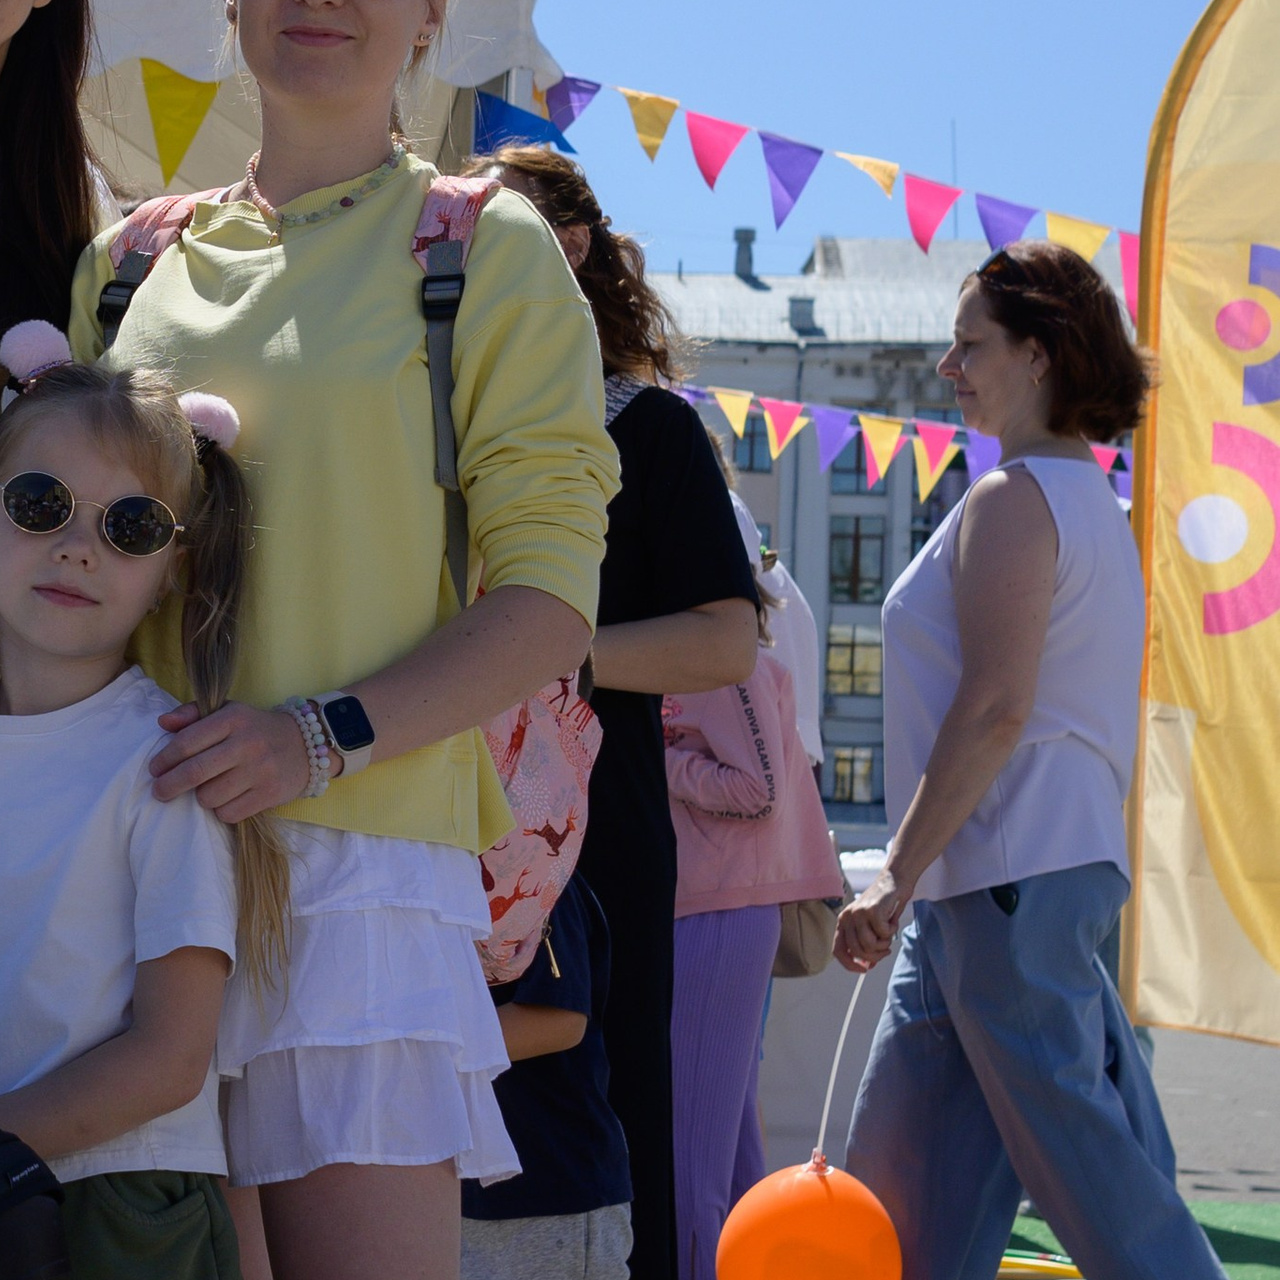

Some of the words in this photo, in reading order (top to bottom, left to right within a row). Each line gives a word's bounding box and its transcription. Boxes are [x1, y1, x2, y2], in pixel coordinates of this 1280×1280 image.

[744, 707, 760, 736] DIVA
[754, 738, 771, 771] GLAM
[765, 774, 776, 802] DIVA
